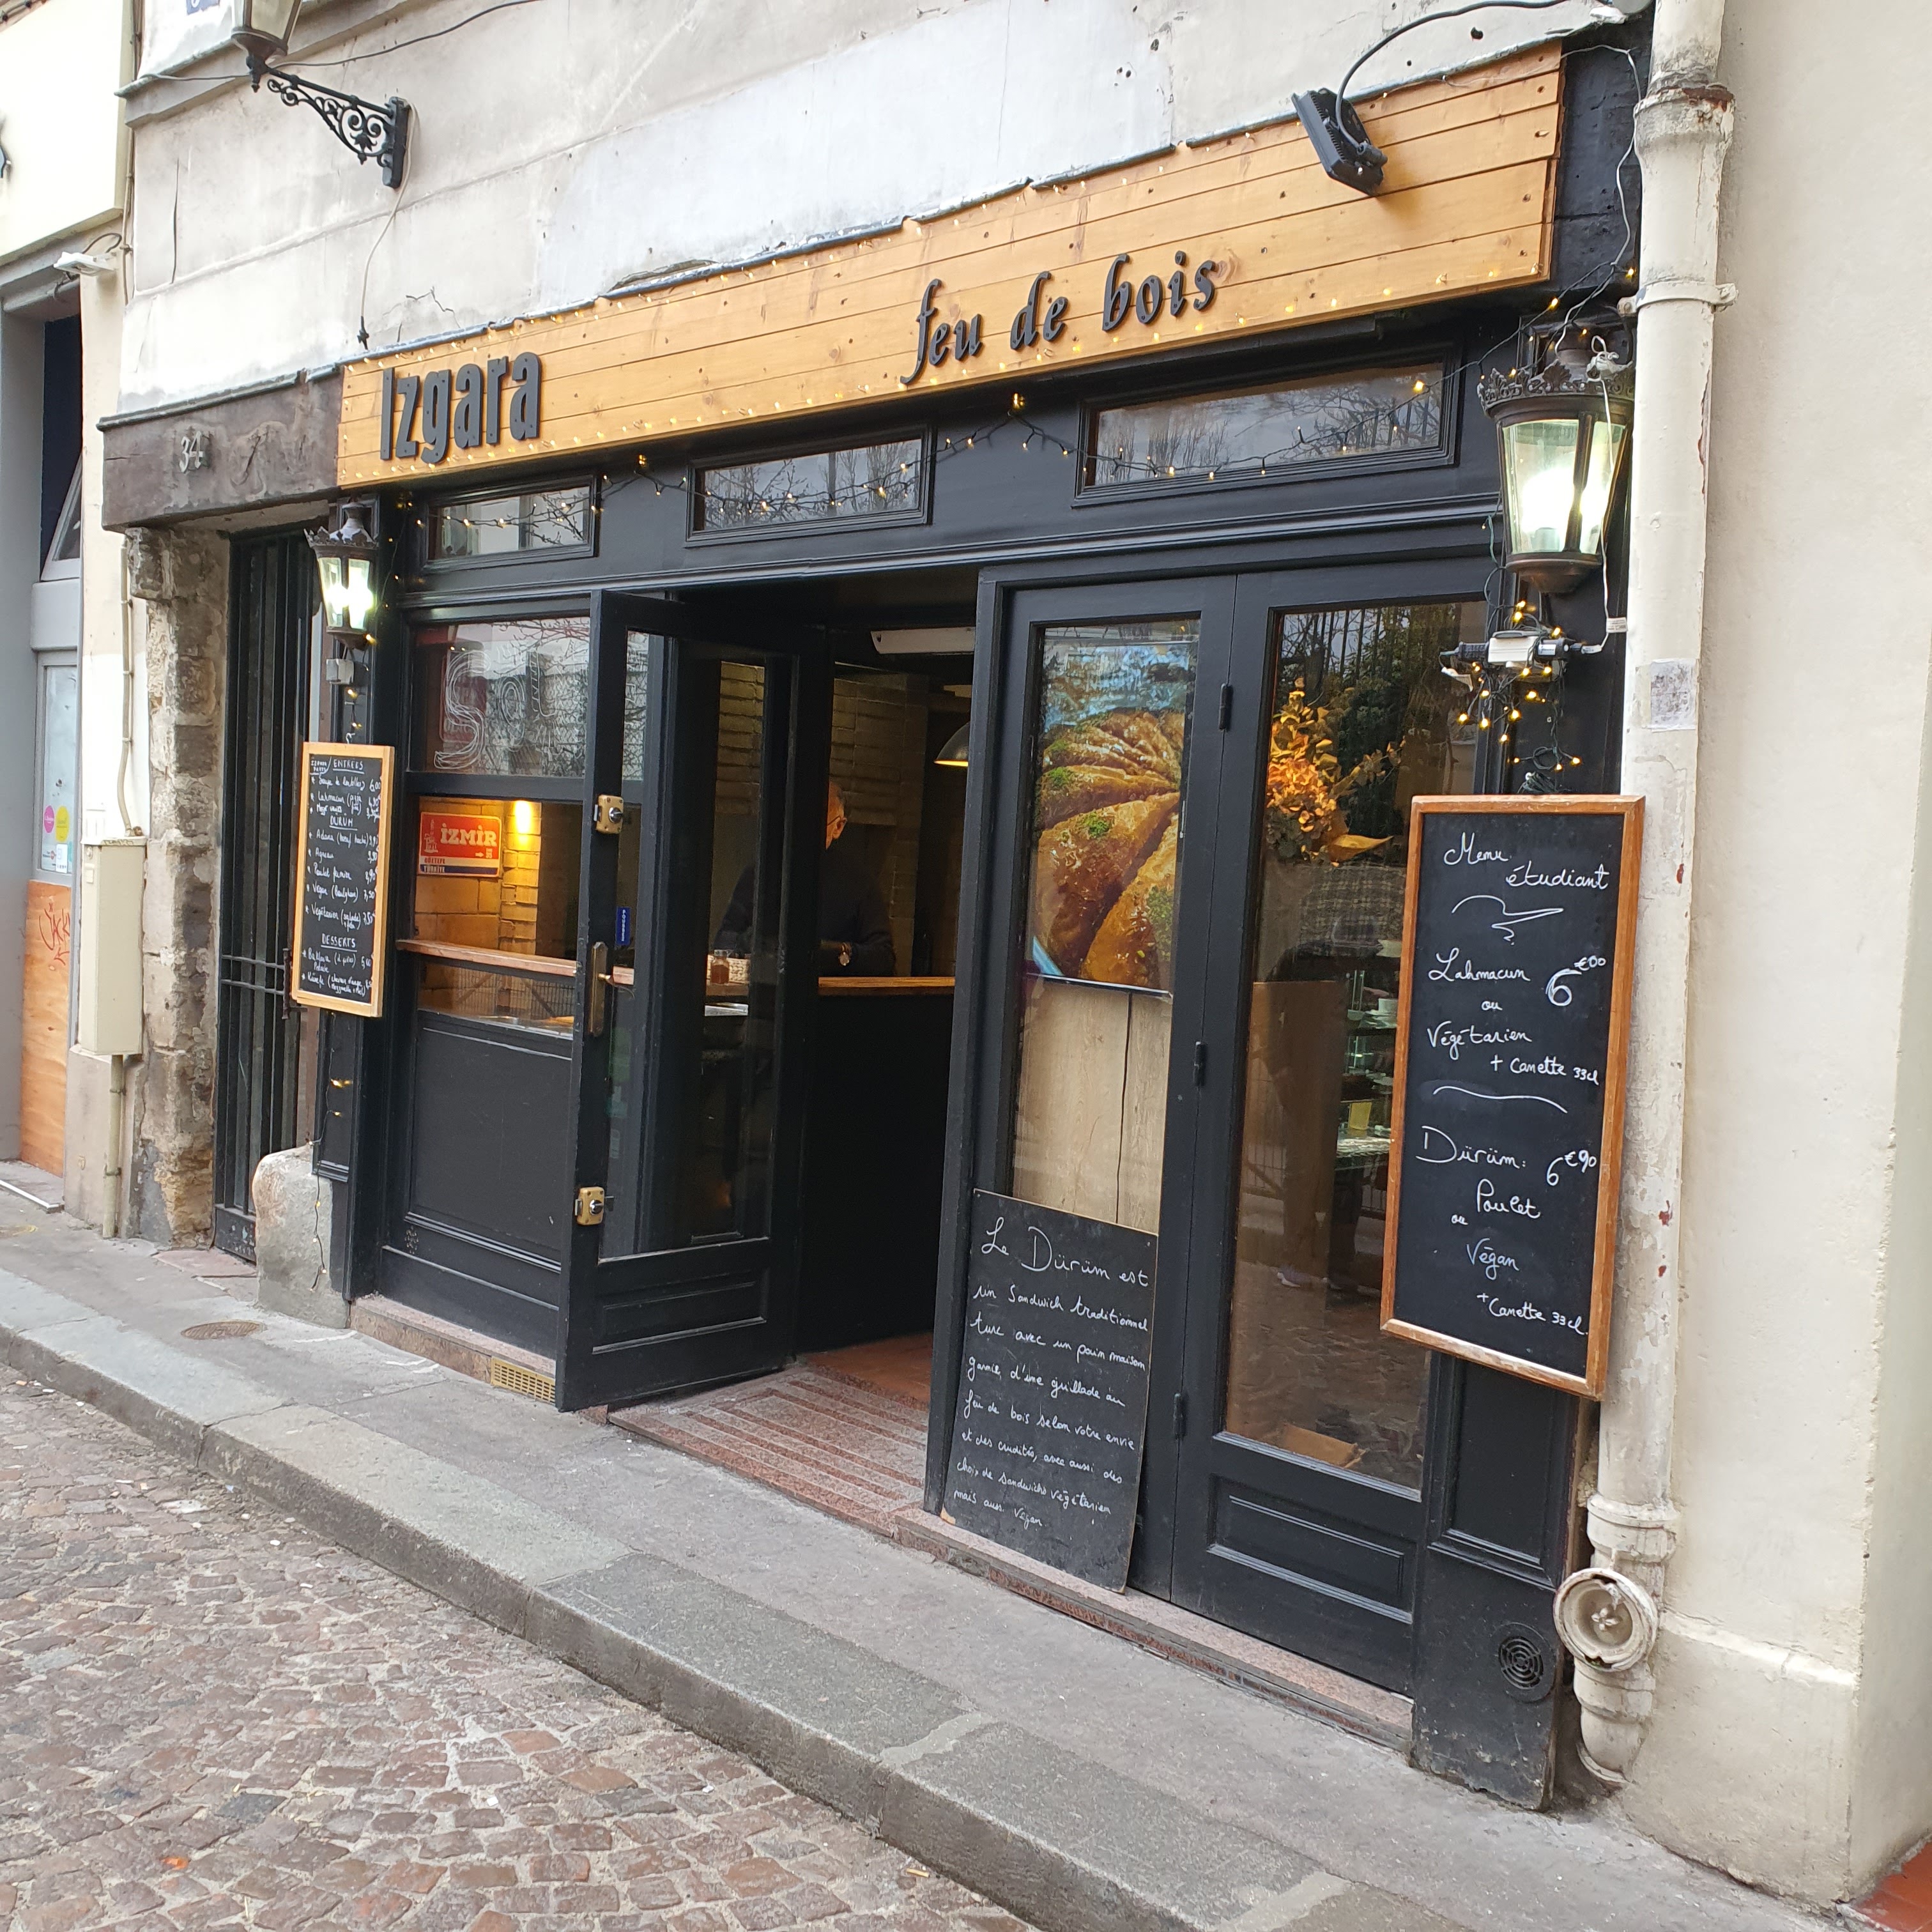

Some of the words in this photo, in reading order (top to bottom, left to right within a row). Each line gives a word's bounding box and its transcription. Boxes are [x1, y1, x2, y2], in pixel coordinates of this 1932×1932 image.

[900, 279, 983, 384] feu
[1010, 271, 1069, 351] de
[1102, 250, 1216, 332] bois
[381, 352, 542, 463] Izgara
[179, 431, 204, 475] 34
[1443, 832, 1508, 864] Menu
[1506, 861, 1609, 890] étudiant
[322, 933, 355, 948] DESSERTS
[1429, 947, 1530, 981] Lahmacun
[1482, 1000, 1503, 1011] ou
[1427, 1021, 1532, 1060] Végétarien
[1476, 1179, 1540, 1219] Poulet
[1451, 1214, 1468, 1225] ou
[981, 1216, 1009, 1255] Le
[1021, 1226, 1110, 1280] Dürüm
[1119, 1269, 1148, 1287] est
[1466, 1238, 1519, 1280] Végan
[973, 1285, 997, 1299] un
[1070, 1295, 1148, 1332] traditionnel
[970, 1311, 1004, 1336] turc
[1015, 1331, 1046, 1346] avec
[1054, 1340, 1072, 1351] un
[1077, 1344, 1105, 1363] pain
[1110, 1351, 1146, 1372] maison
[963, 1390, 983, 1419] feu
[988, 1402, 1000, 1414] de
[1011, 1404, 1030, 1425] bois
[1036, 1415, 1071, 1433] selon
[1075, 1424, 1101, 1440] votre
[1105, 1433, 1135, 1450] envie
[1106, 1394, 1126, 1407] au
[962, 1427, 972, 1442] et
[976, 1434, 993, 1448] des
[1043, 1454, 1065, 1466] avec
[1069, 1459, 1094, 1473] aussi
[1103, 1471, 1123, 1484] des
[982, 1467, 993, 1480] de
[954, 1489, 977, 1504] mais
